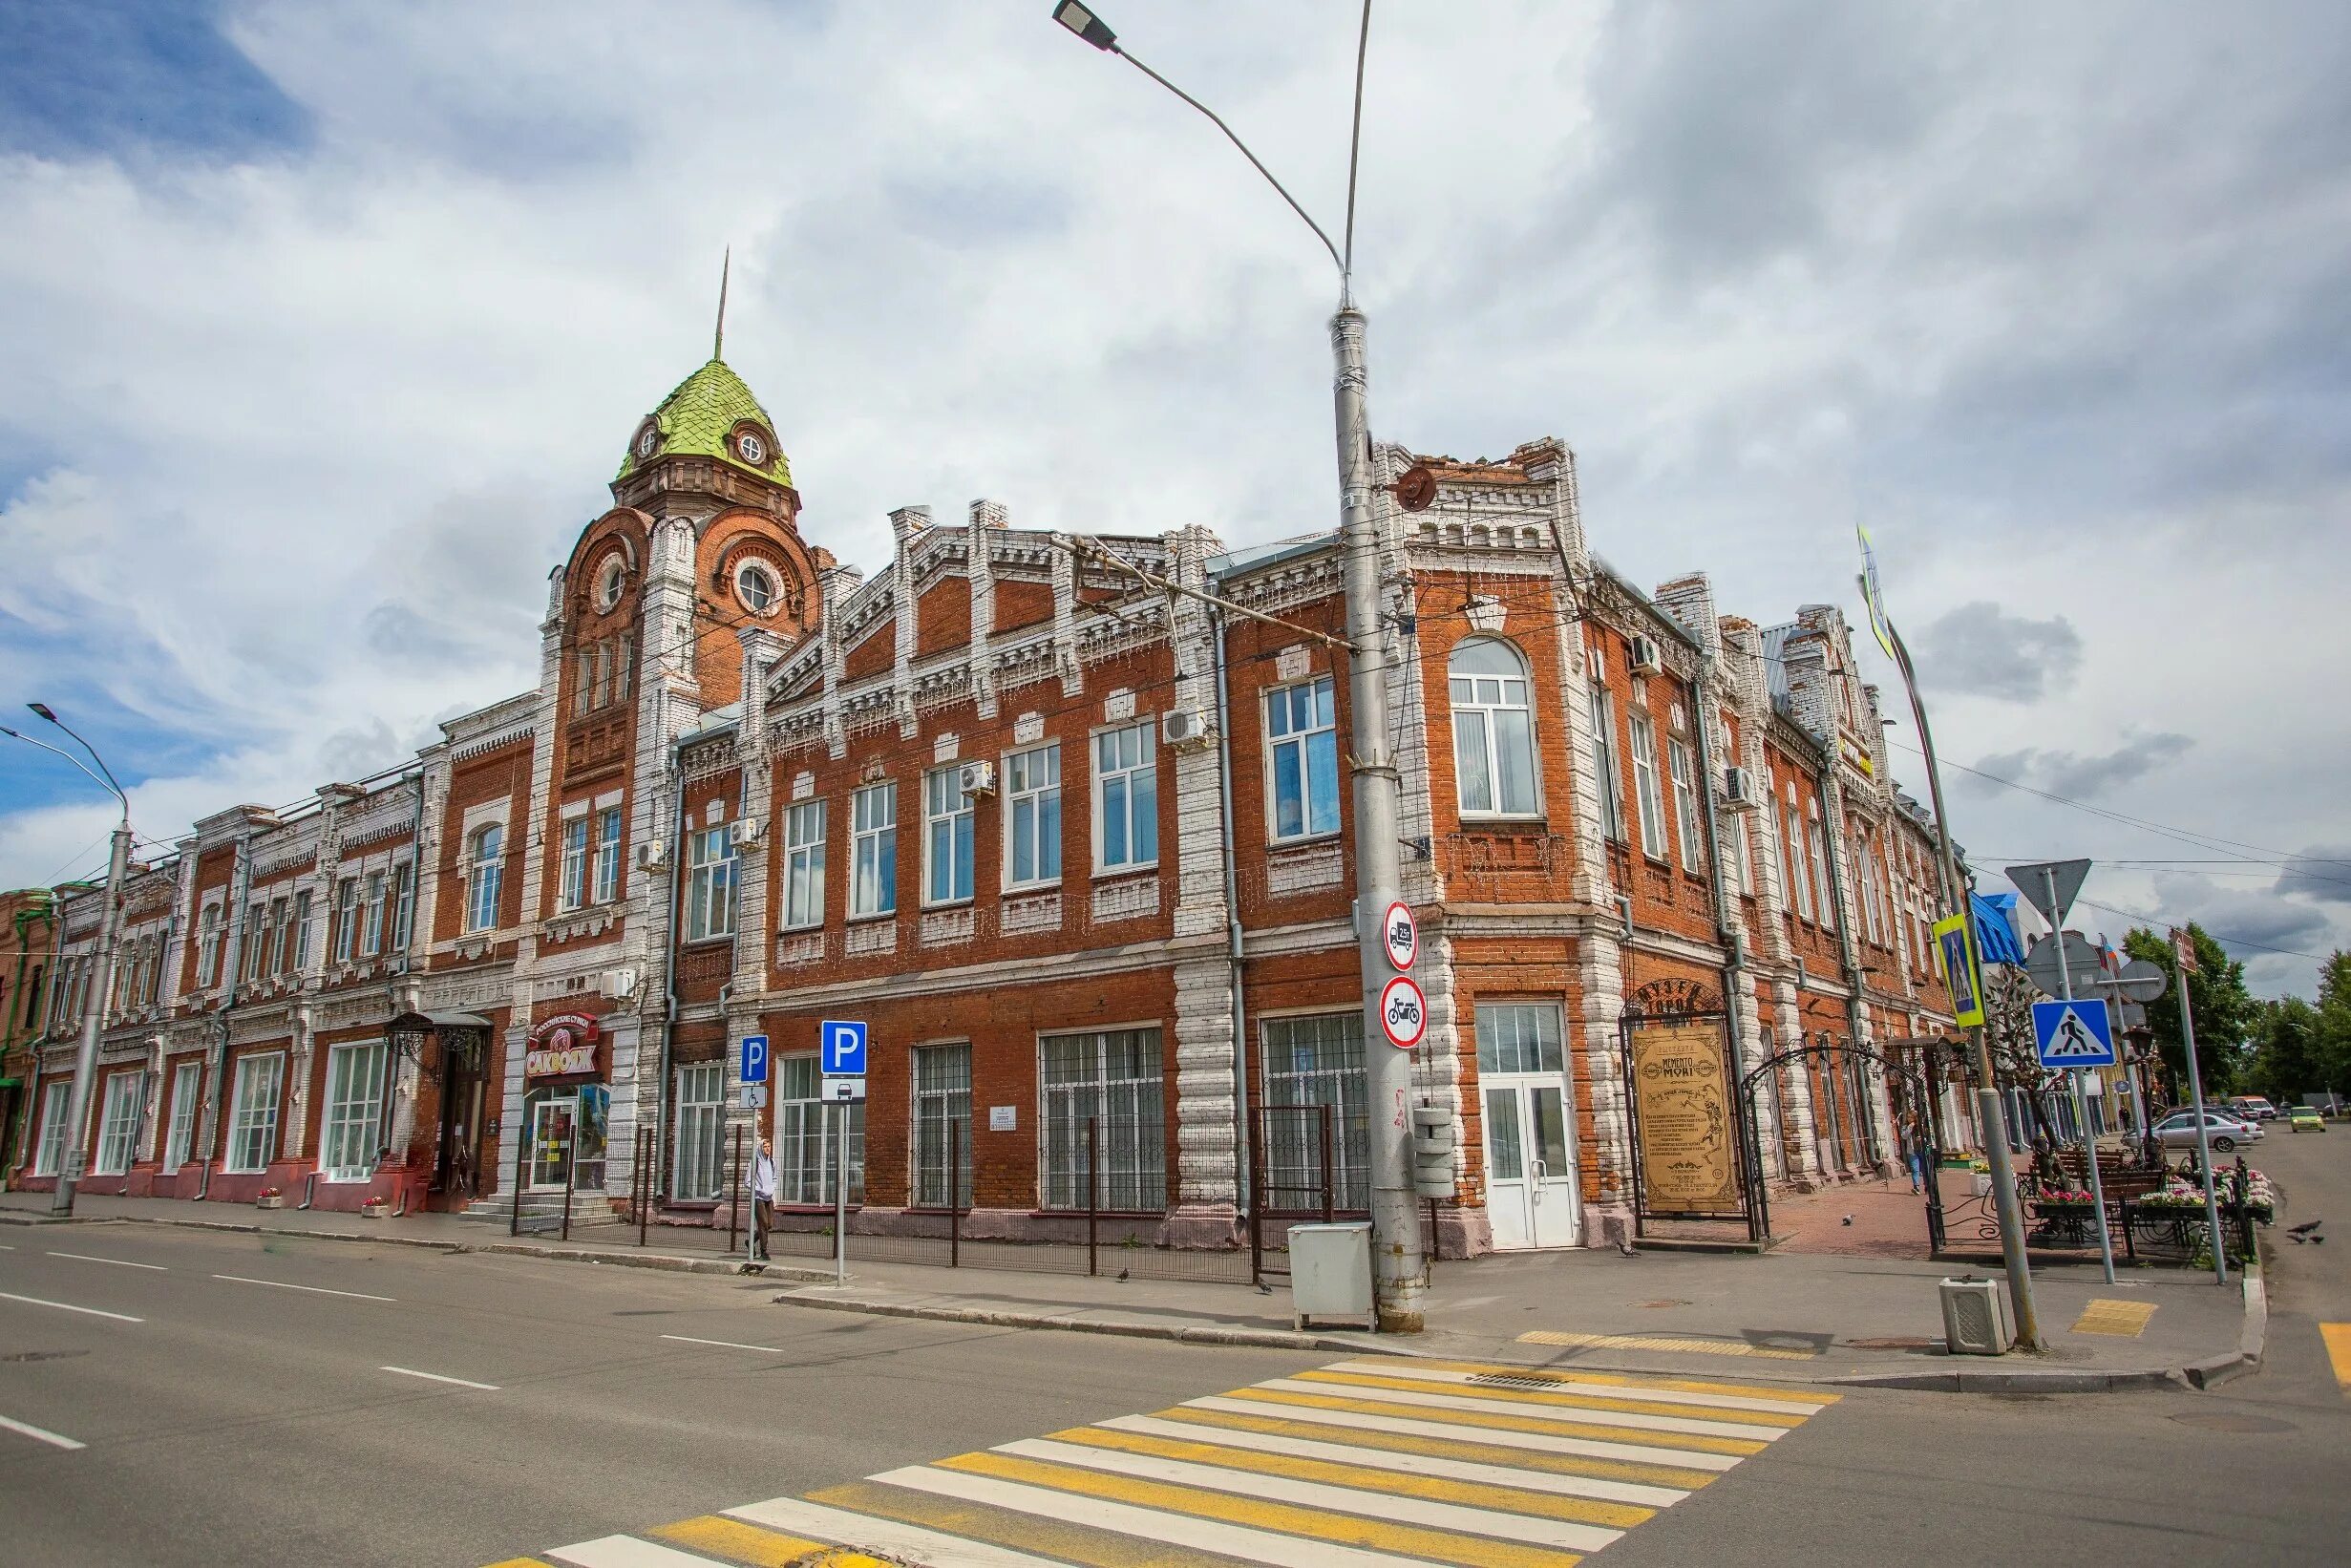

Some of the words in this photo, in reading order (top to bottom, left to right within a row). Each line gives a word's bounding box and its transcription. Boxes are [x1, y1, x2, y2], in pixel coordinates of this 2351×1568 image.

[748, 1042, 763, 1077] P
[835, 1028, 858, 1068] P
[526, 1049, 594, 1074] САКВОЯЖ
[1663, 1057, 1693, 1069] MEMENTO
[1663, 1068, 1693, 1077] MORI
